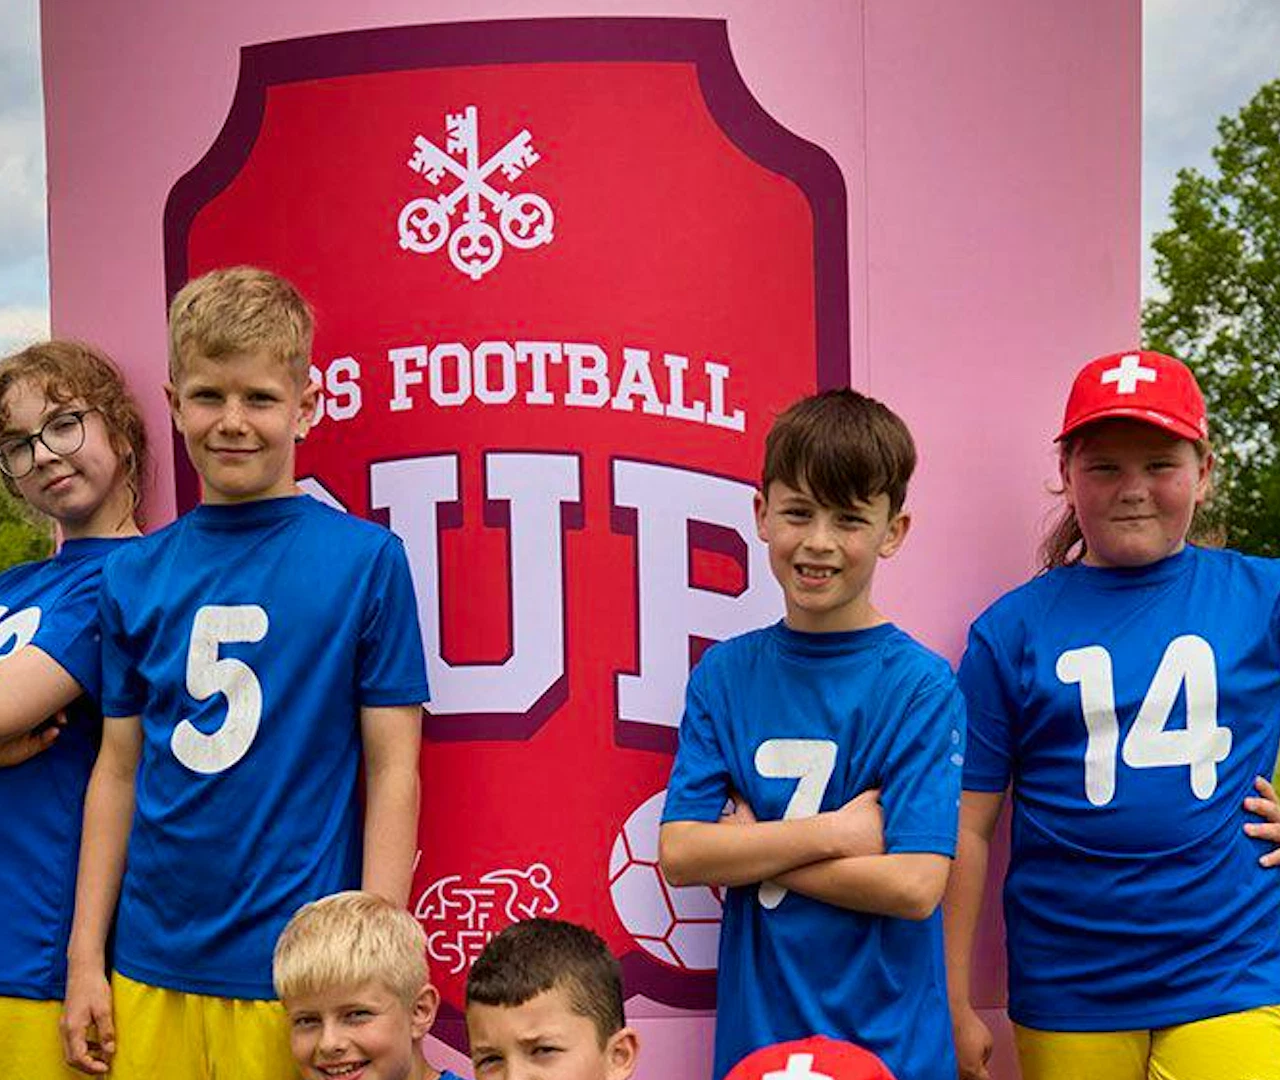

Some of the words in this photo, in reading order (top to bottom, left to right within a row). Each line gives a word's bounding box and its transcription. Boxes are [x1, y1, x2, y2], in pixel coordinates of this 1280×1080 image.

[387, 340, 746, 433] FOOTBALL
[297, 453, 786, 728] UP
[170, 604, 269, 774] 5
[1055, 634, 1233, 807] 14
[754, 738, 839, 910] 7
